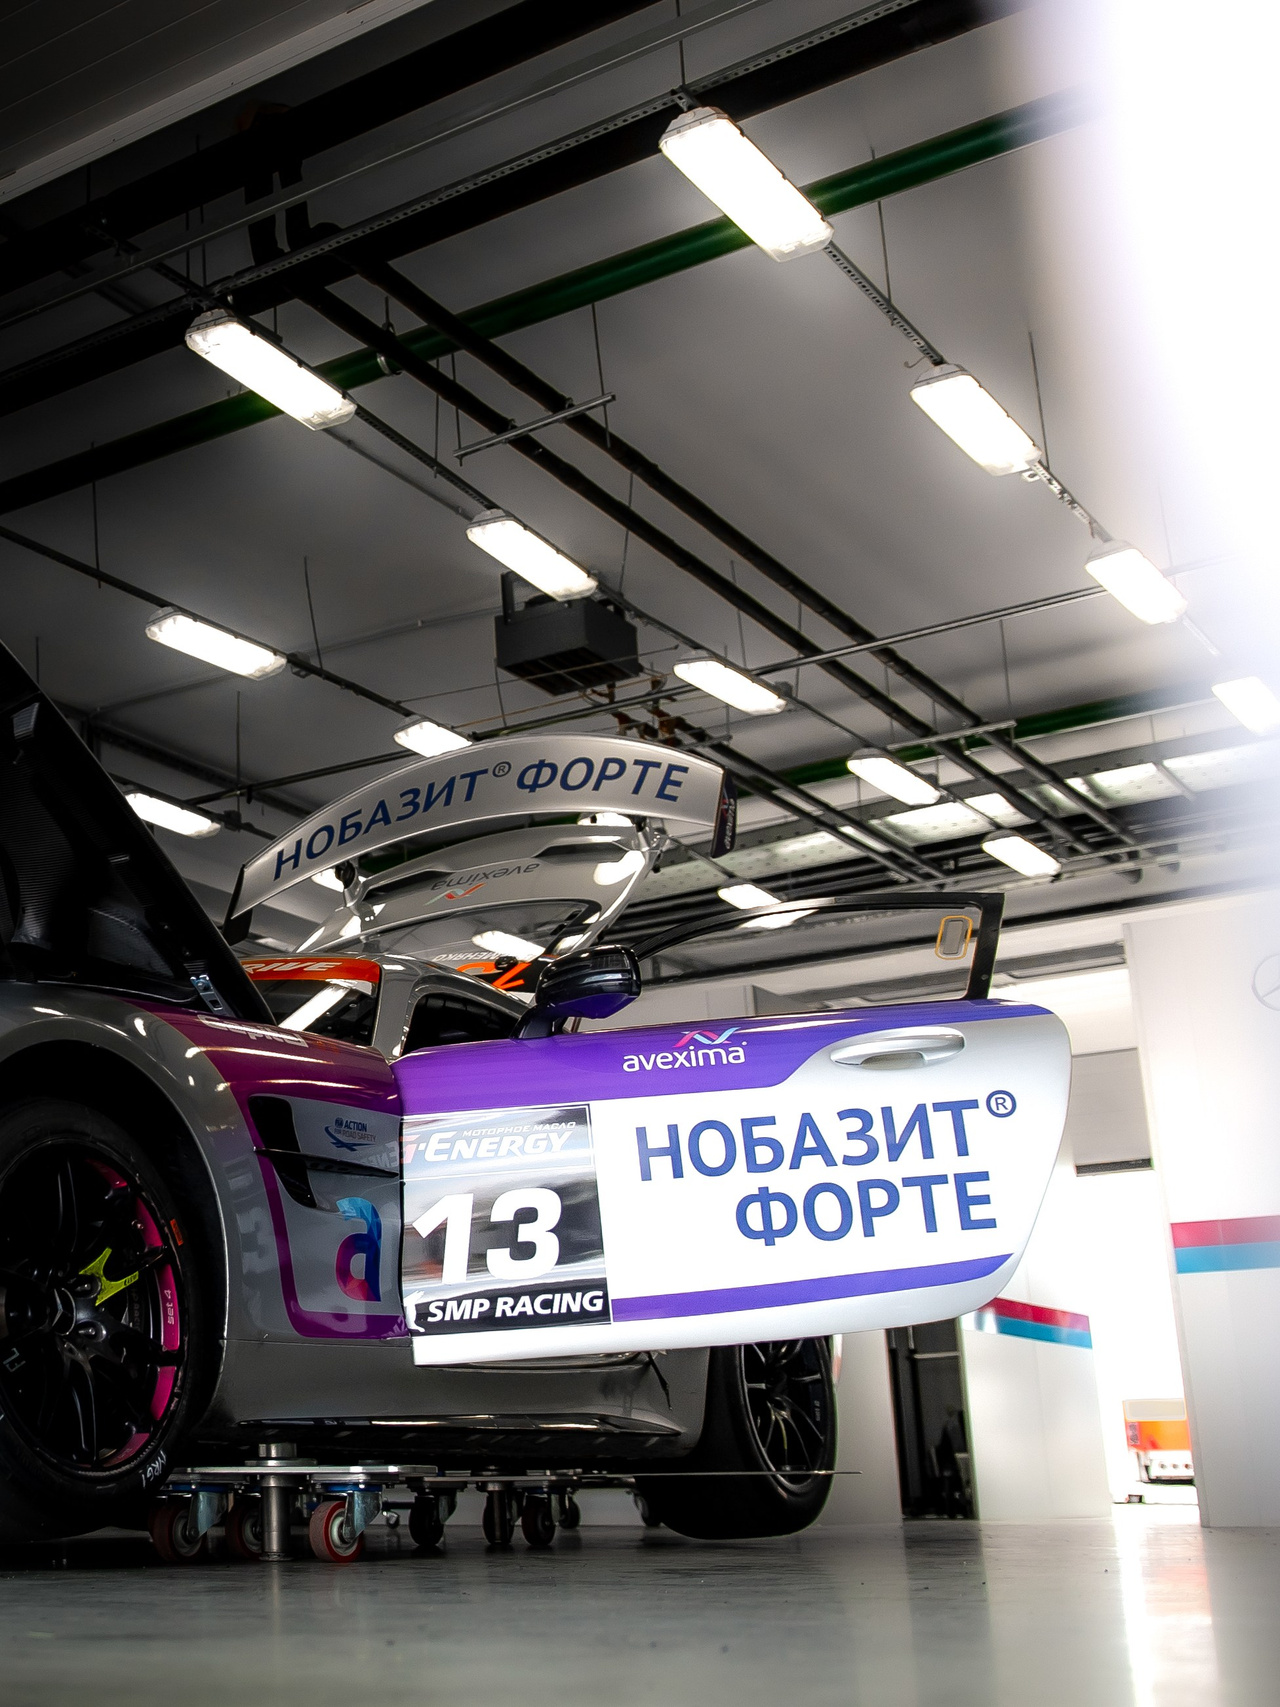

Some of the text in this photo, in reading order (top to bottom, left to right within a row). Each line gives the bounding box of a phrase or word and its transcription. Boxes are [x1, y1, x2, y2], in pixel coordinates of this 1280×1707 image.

[516, 757, 690, 802] ФОРТЕ
[430, 863, 541, 891] avexima
[622, 1045, 747, 1073] avexima
[342, 1130, 358, 1139] ROAD
[357, 1133, 376, 1142] SAFETY
[344, 1120, 368, 1132] ACTION
[462, 1121, 576, 1137] МОТОРНОЕ МАСЛО
[735, 1171, 999, 1247] ФОРТЕ
[412, 1187, 562, 1285] 13
[426, 1290, 604, 1322] SMP RACING
